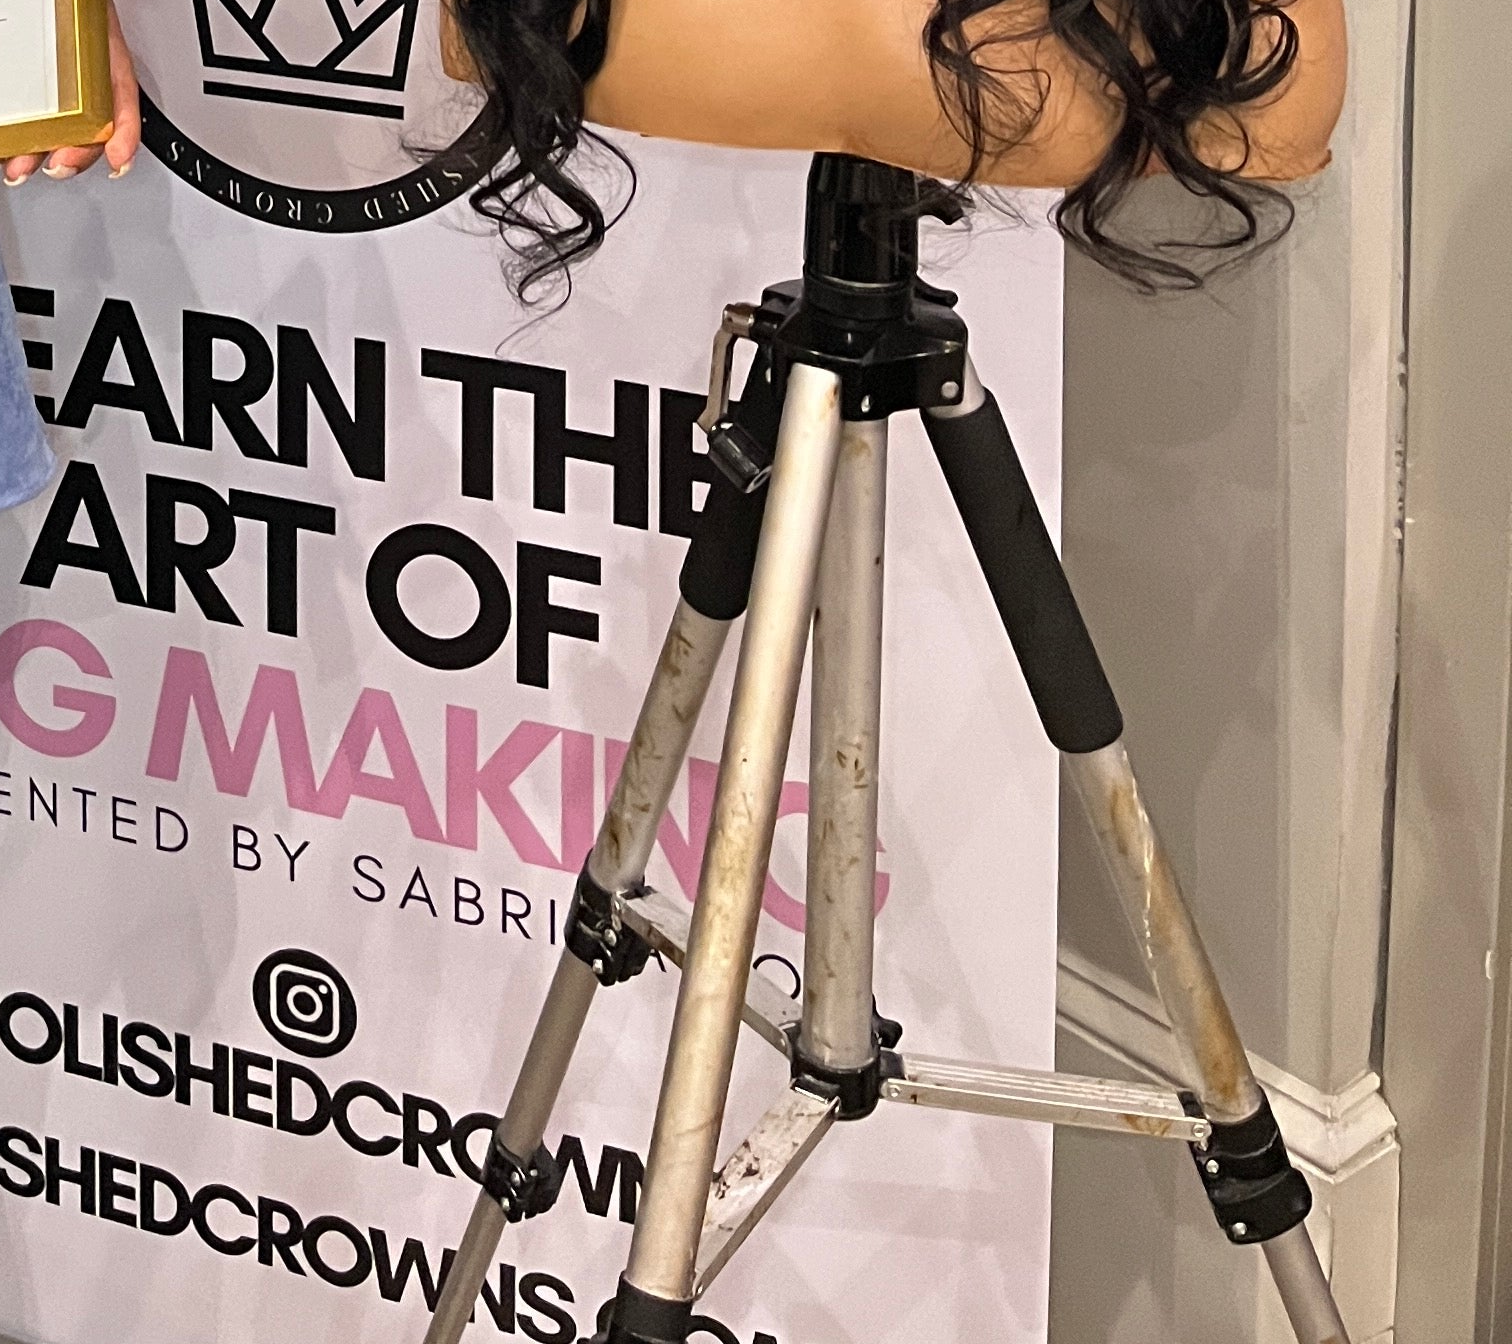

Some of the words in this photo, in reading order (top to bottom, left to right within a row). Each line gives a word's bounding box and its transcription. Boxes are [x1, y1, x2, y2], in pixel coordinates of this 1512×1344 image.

[20, 459, 337, 638] ART
[366, 523, 602, 690] OF
[232, 824, 310, 882] BY
